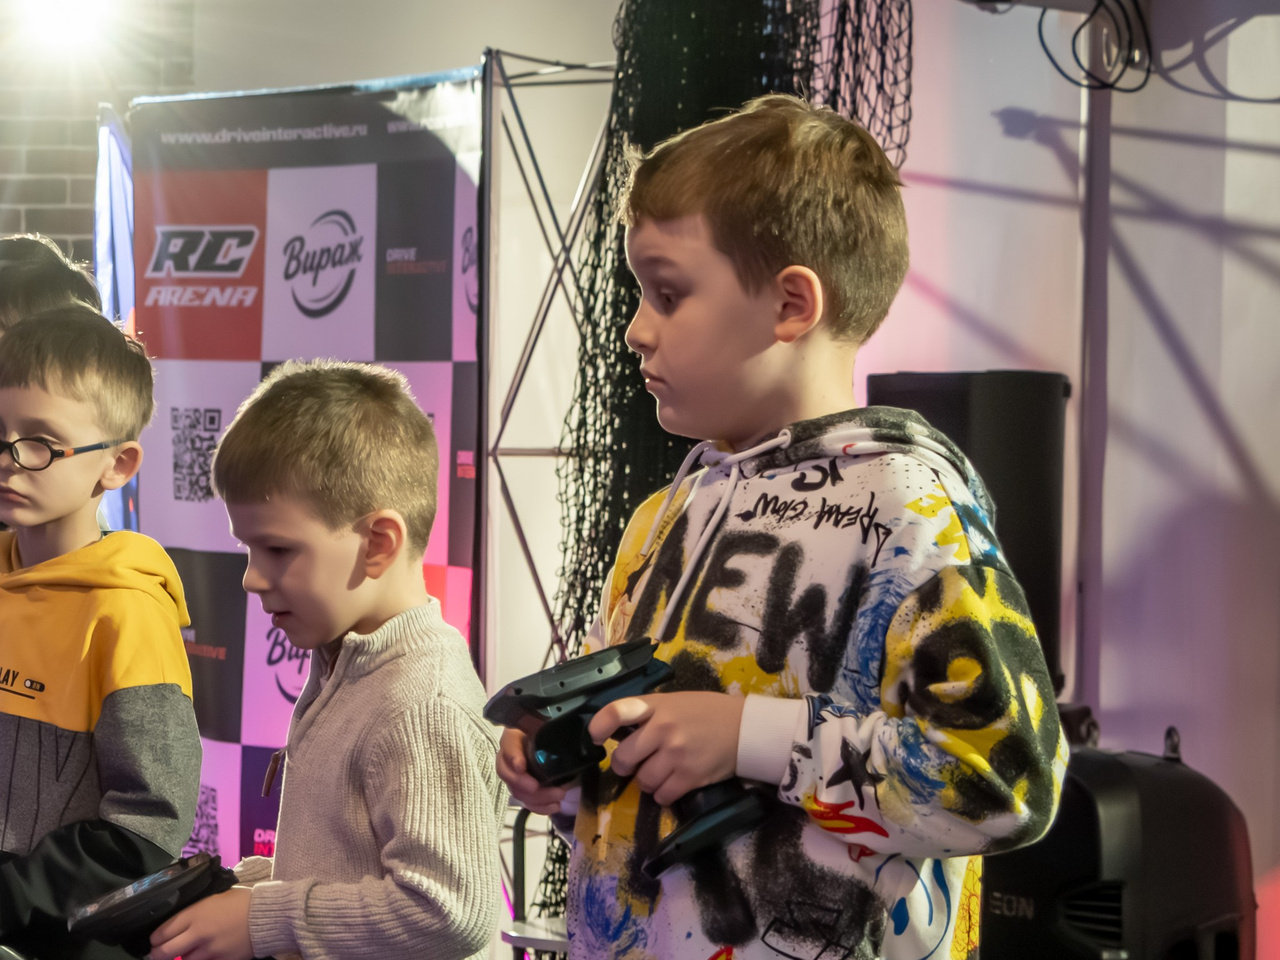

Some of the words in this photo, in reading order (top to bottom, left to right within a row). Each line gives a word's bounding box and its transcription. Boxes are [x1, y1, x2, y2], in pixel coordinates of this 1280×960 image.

[160, 122, 368, 144] www.driveinteractive.ru
[145, 224, 259, 279] RC
[282, 232, 364, 288] Вираж
[144, 285, 258, 307] ARENA
